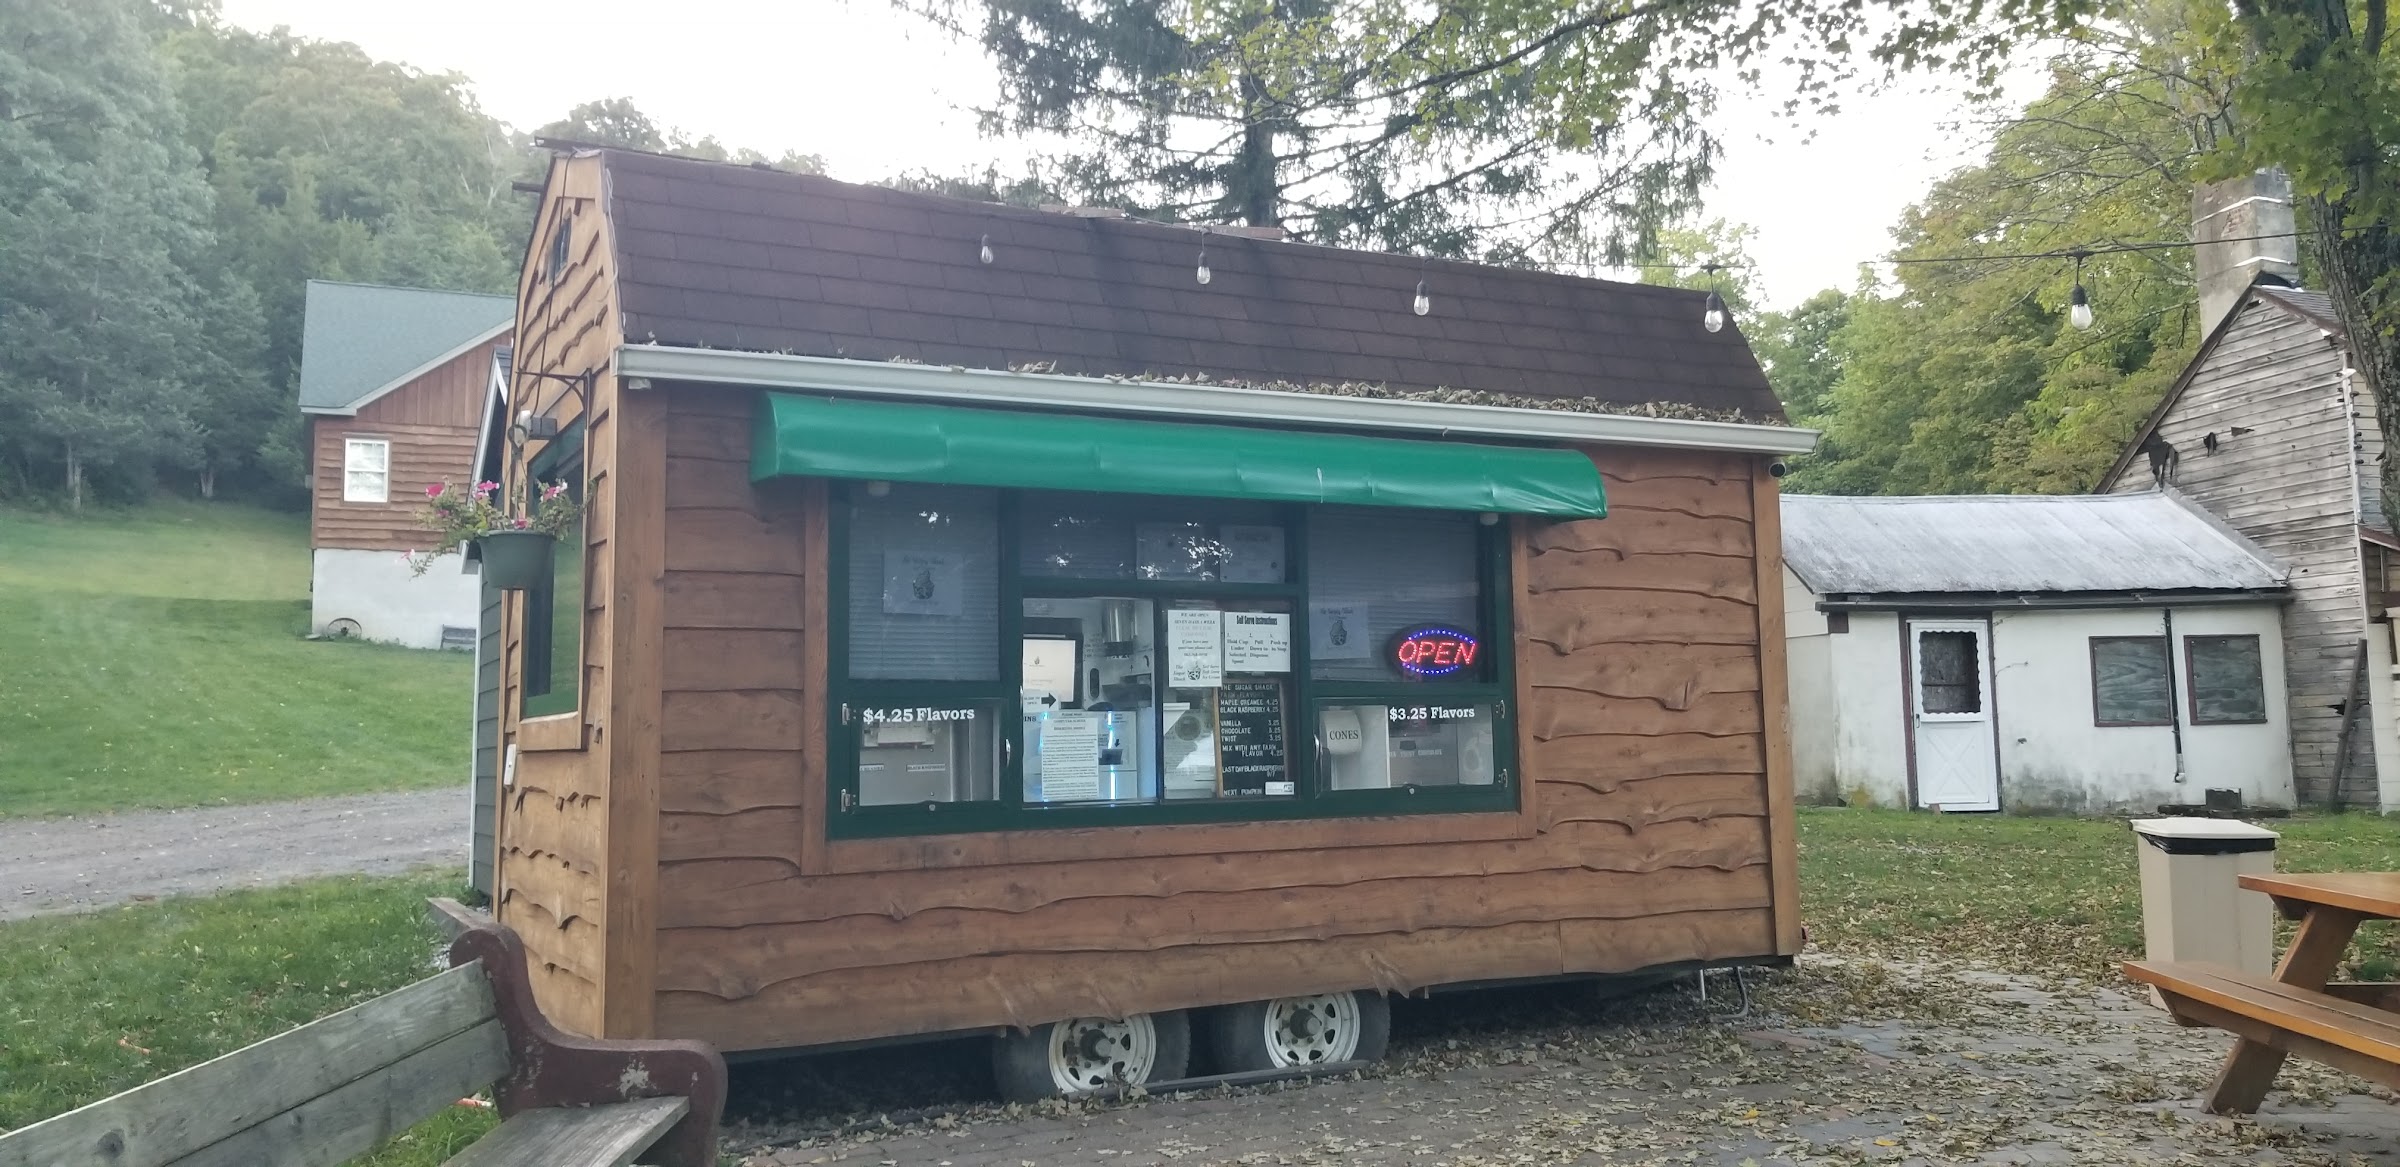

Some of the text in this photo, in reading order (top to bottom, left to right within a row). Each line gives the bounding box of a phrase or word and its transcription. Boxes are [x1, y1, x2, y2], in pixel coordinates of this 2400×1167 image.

[1245, 615, 1254, 625] Serve
[1255, 616, 1278, 626] Instructions
[1398, 640, 1476, 666] OPEN
[863, 707, 975, 724] $4.25 Flavors
[1389, 706, 1475, 722] $3.25 Flavors
[1329, 730, 1359, 740] CONES
